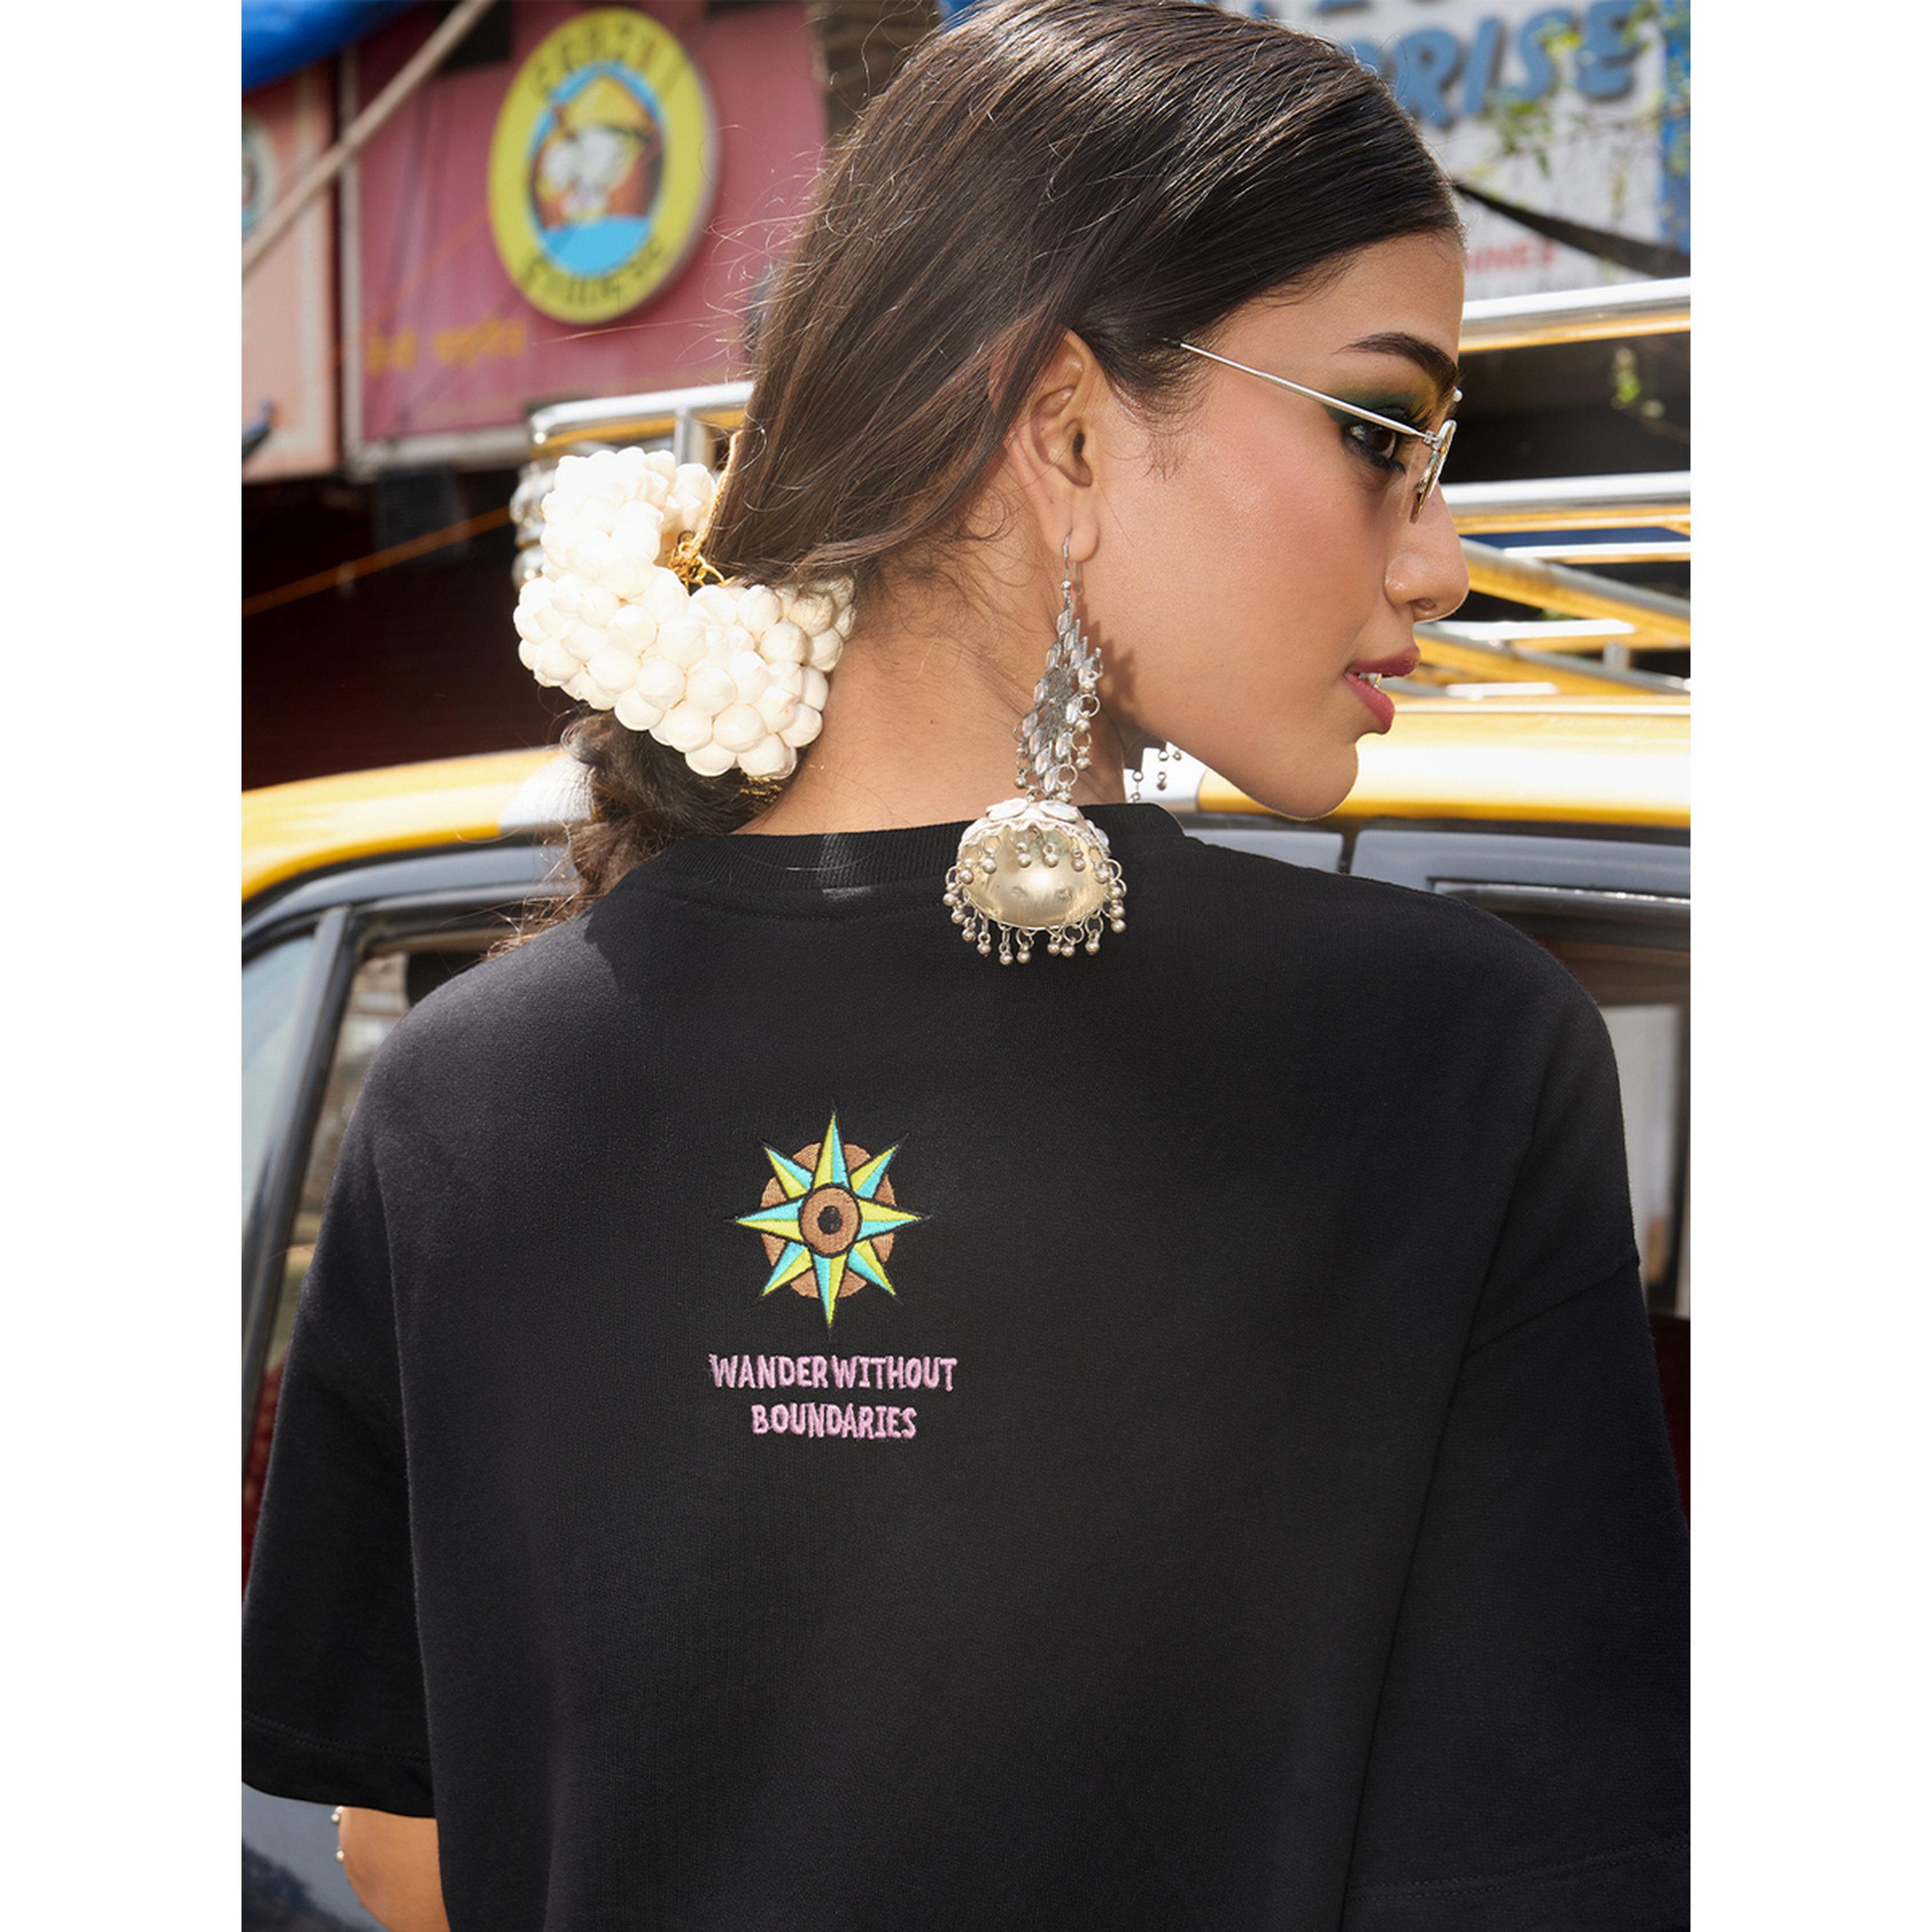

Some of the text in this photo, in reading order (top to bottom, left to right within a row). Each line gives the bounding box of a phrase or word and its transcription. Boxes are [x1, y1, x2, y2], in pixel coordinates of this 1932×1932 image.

[709, 1354, 958, 1392] WANDER WITHOUT
[751, 1402, 917, 1439] BOUNDARIES
